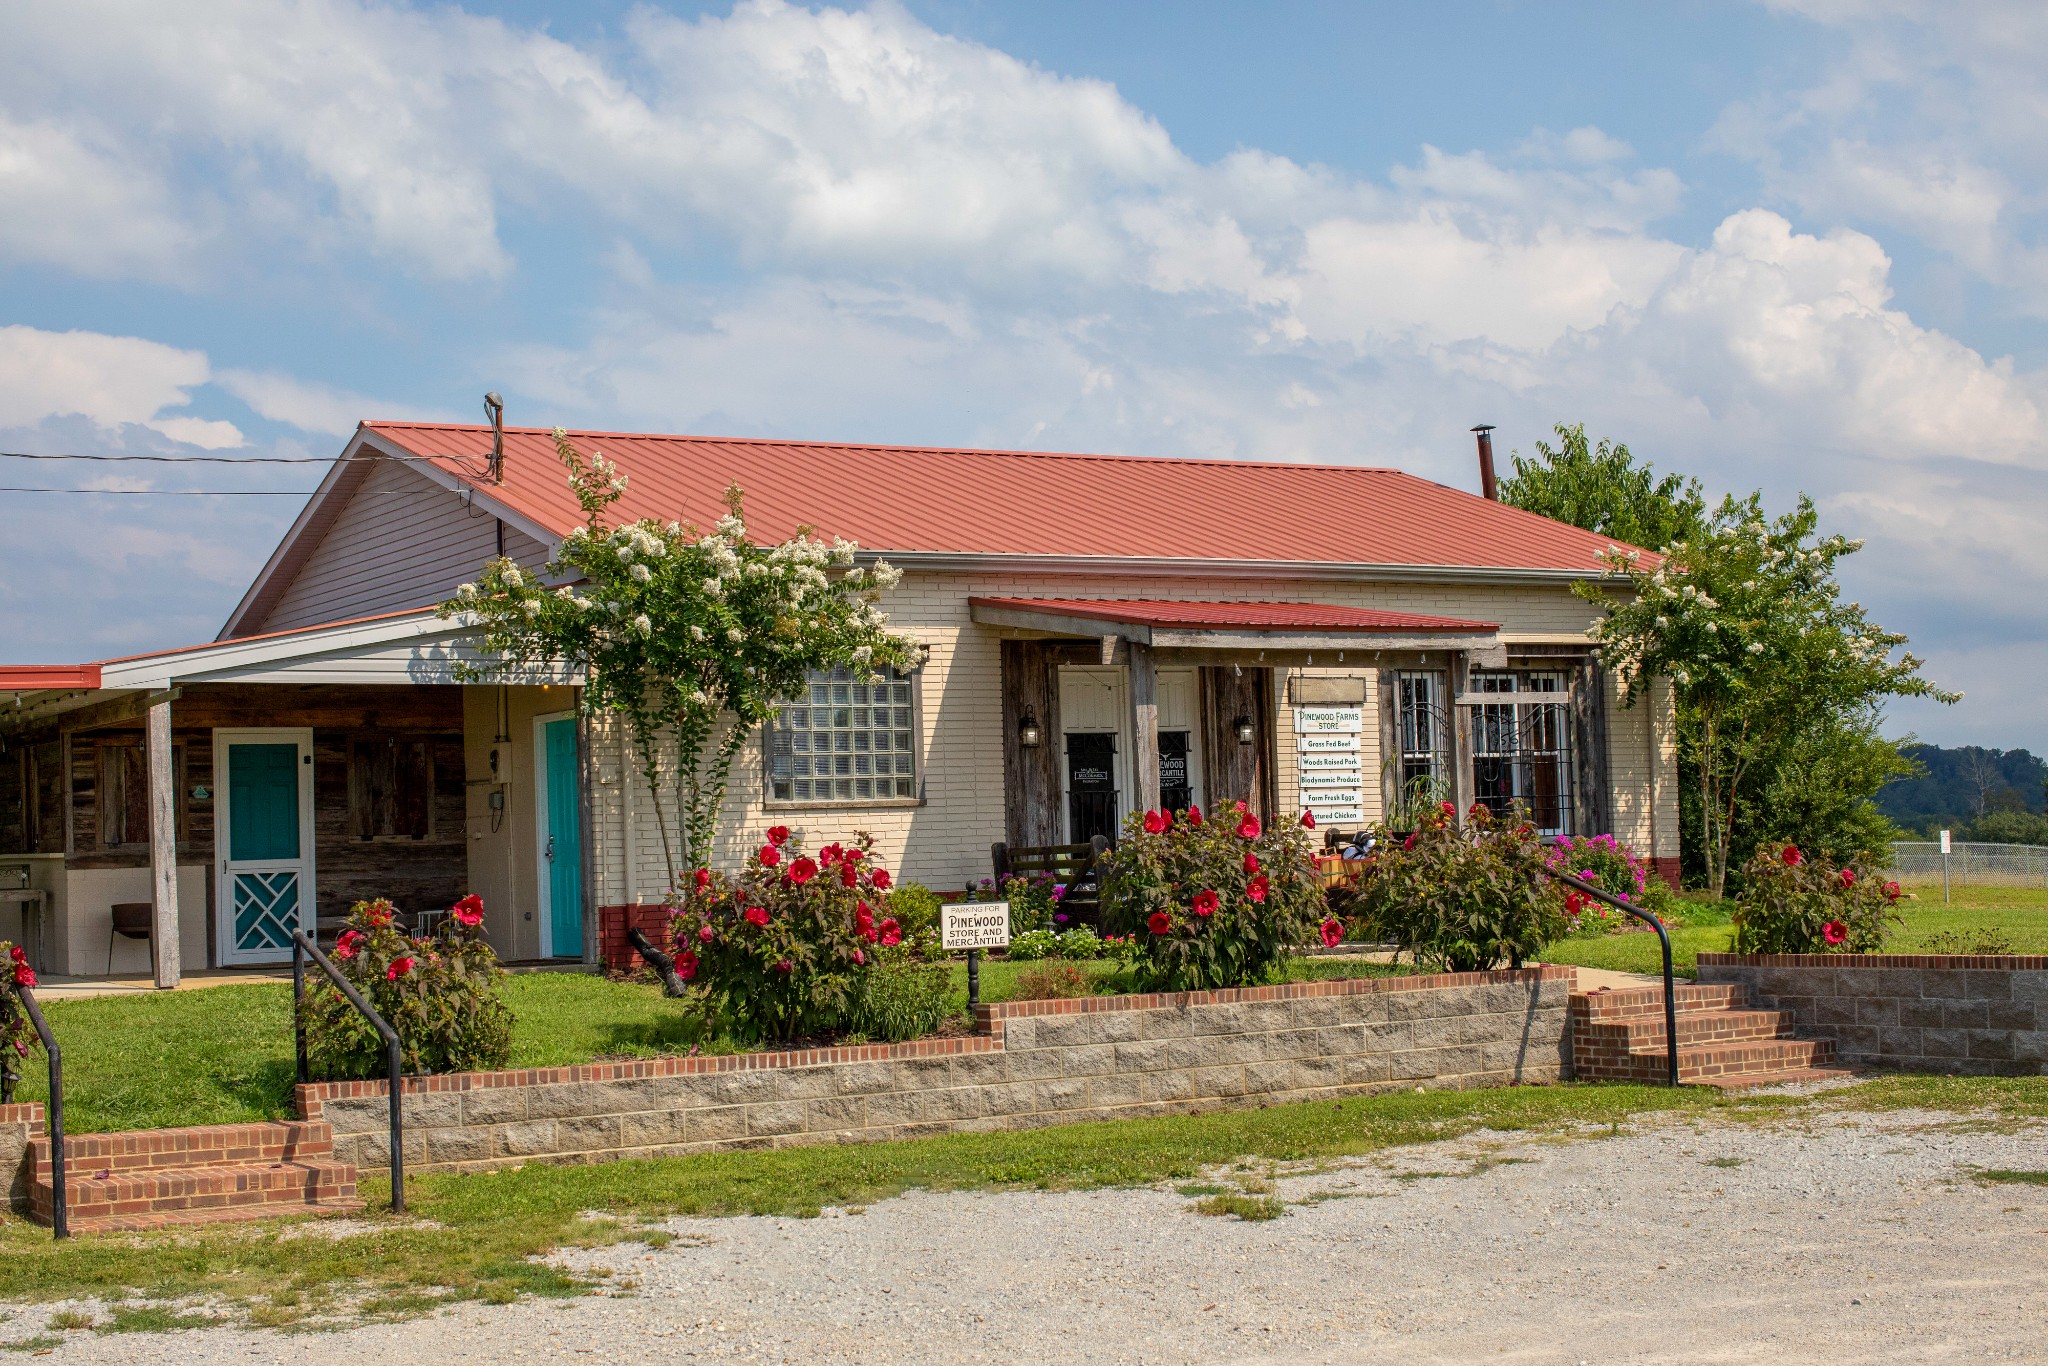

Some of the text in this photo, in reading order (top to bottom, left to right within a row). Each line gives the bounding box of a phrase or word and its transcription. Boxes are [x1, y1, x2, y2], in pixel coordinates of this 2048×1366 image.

[1298, 711, 1359, 722] PINEWOOD FARMS
[1160, 761, 1184, 769] EWOOD
[1301, 776, 1335, 784] Biodynamic
[1342, 794, 1355, 802] Eggs
[948, 915, 1004, 928] PINEWOOD
[949, 928, 1002, 938] STORE AND
[947, 937, 1005, 947] MERCANTILE
